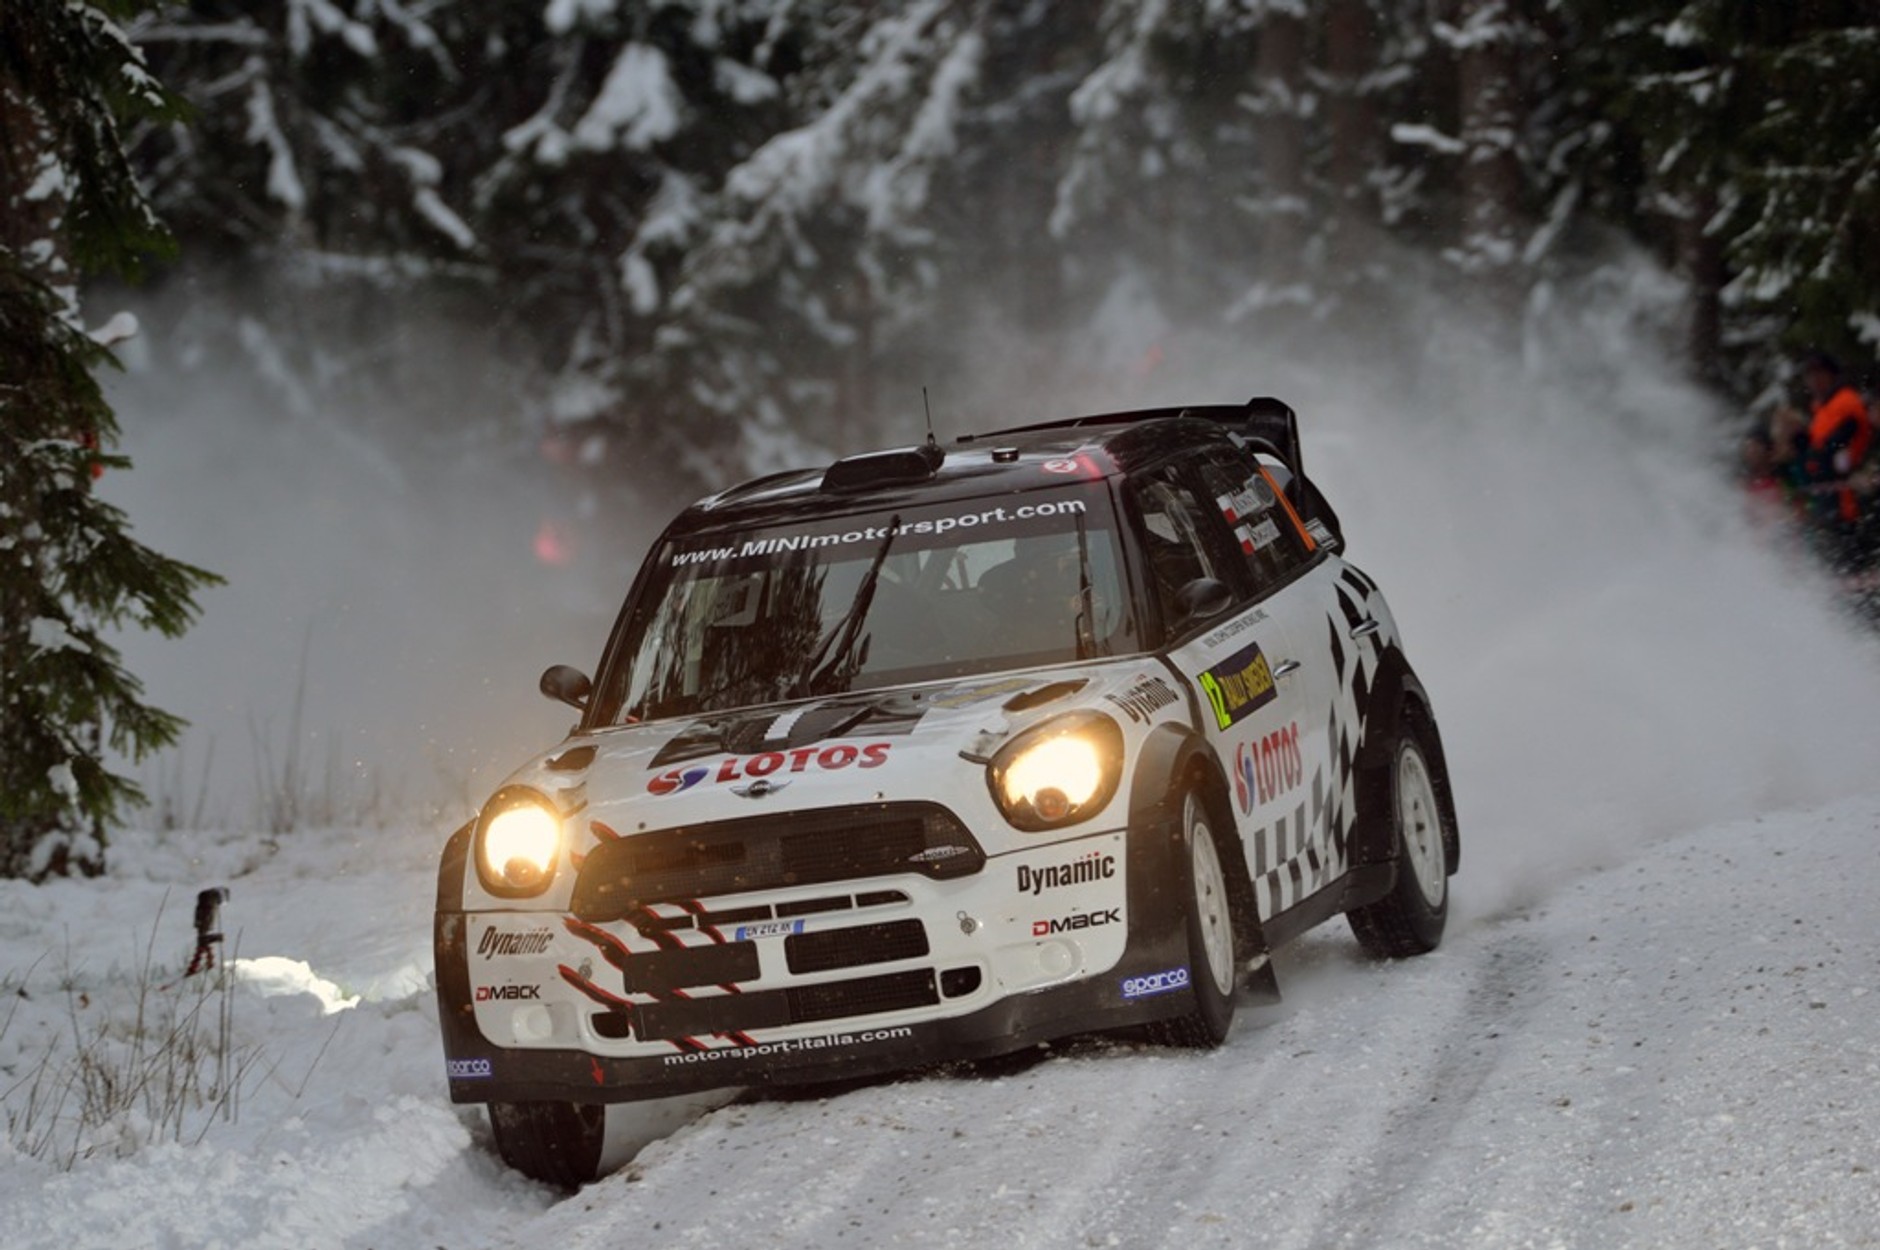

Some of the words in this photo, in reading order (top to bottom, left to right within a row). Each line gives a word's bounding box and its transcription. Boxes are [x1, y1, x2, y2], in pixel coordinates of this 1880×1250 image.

[671, 499, 1086, 567] www.MINImotorsport.com
[715, 743, 892, 783] LOTOS
[1252, 720, 1303, 806] LOTOS
[1017, 851, 1116, 895] Dynamic
[477, 926, 554, 960] Dynamic
[1123, 968, 1189, 997] sparco
[664, 1026, 913, 1066] motorsport-italia.com
